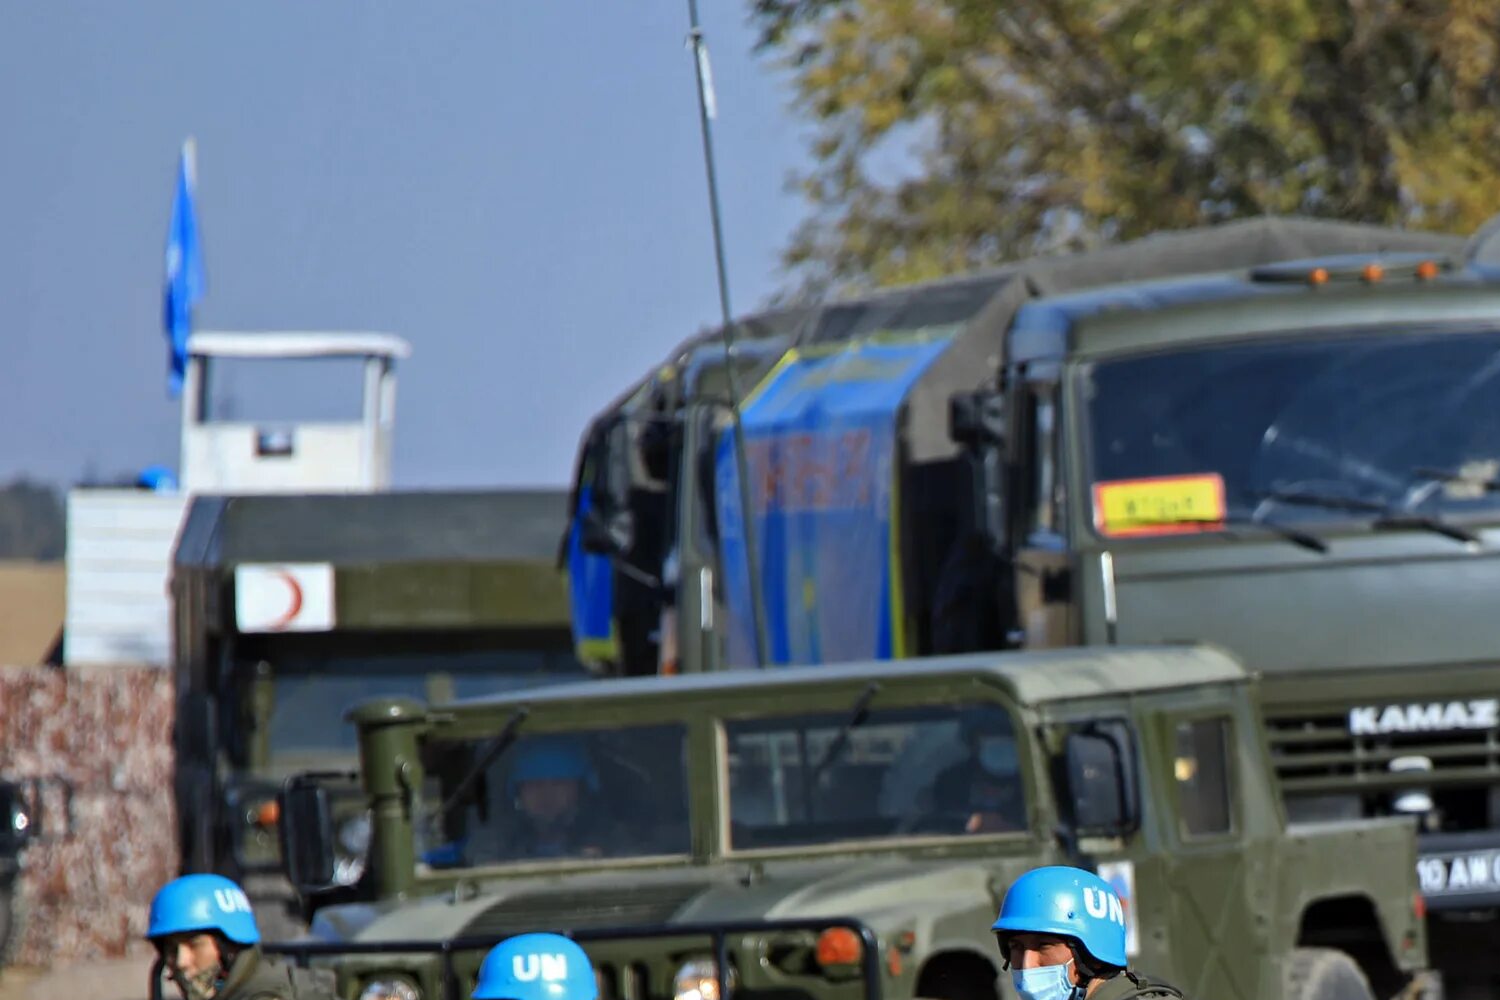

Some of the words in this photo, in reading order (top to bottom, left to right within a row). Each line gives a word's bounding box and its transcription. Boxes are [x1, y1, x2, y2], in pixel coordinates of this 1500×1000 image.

[1349, 699, 1499, 735] KAMAZ
[1083, 887, 1124, 926] UN
[512, 953, 567, 982] UN
